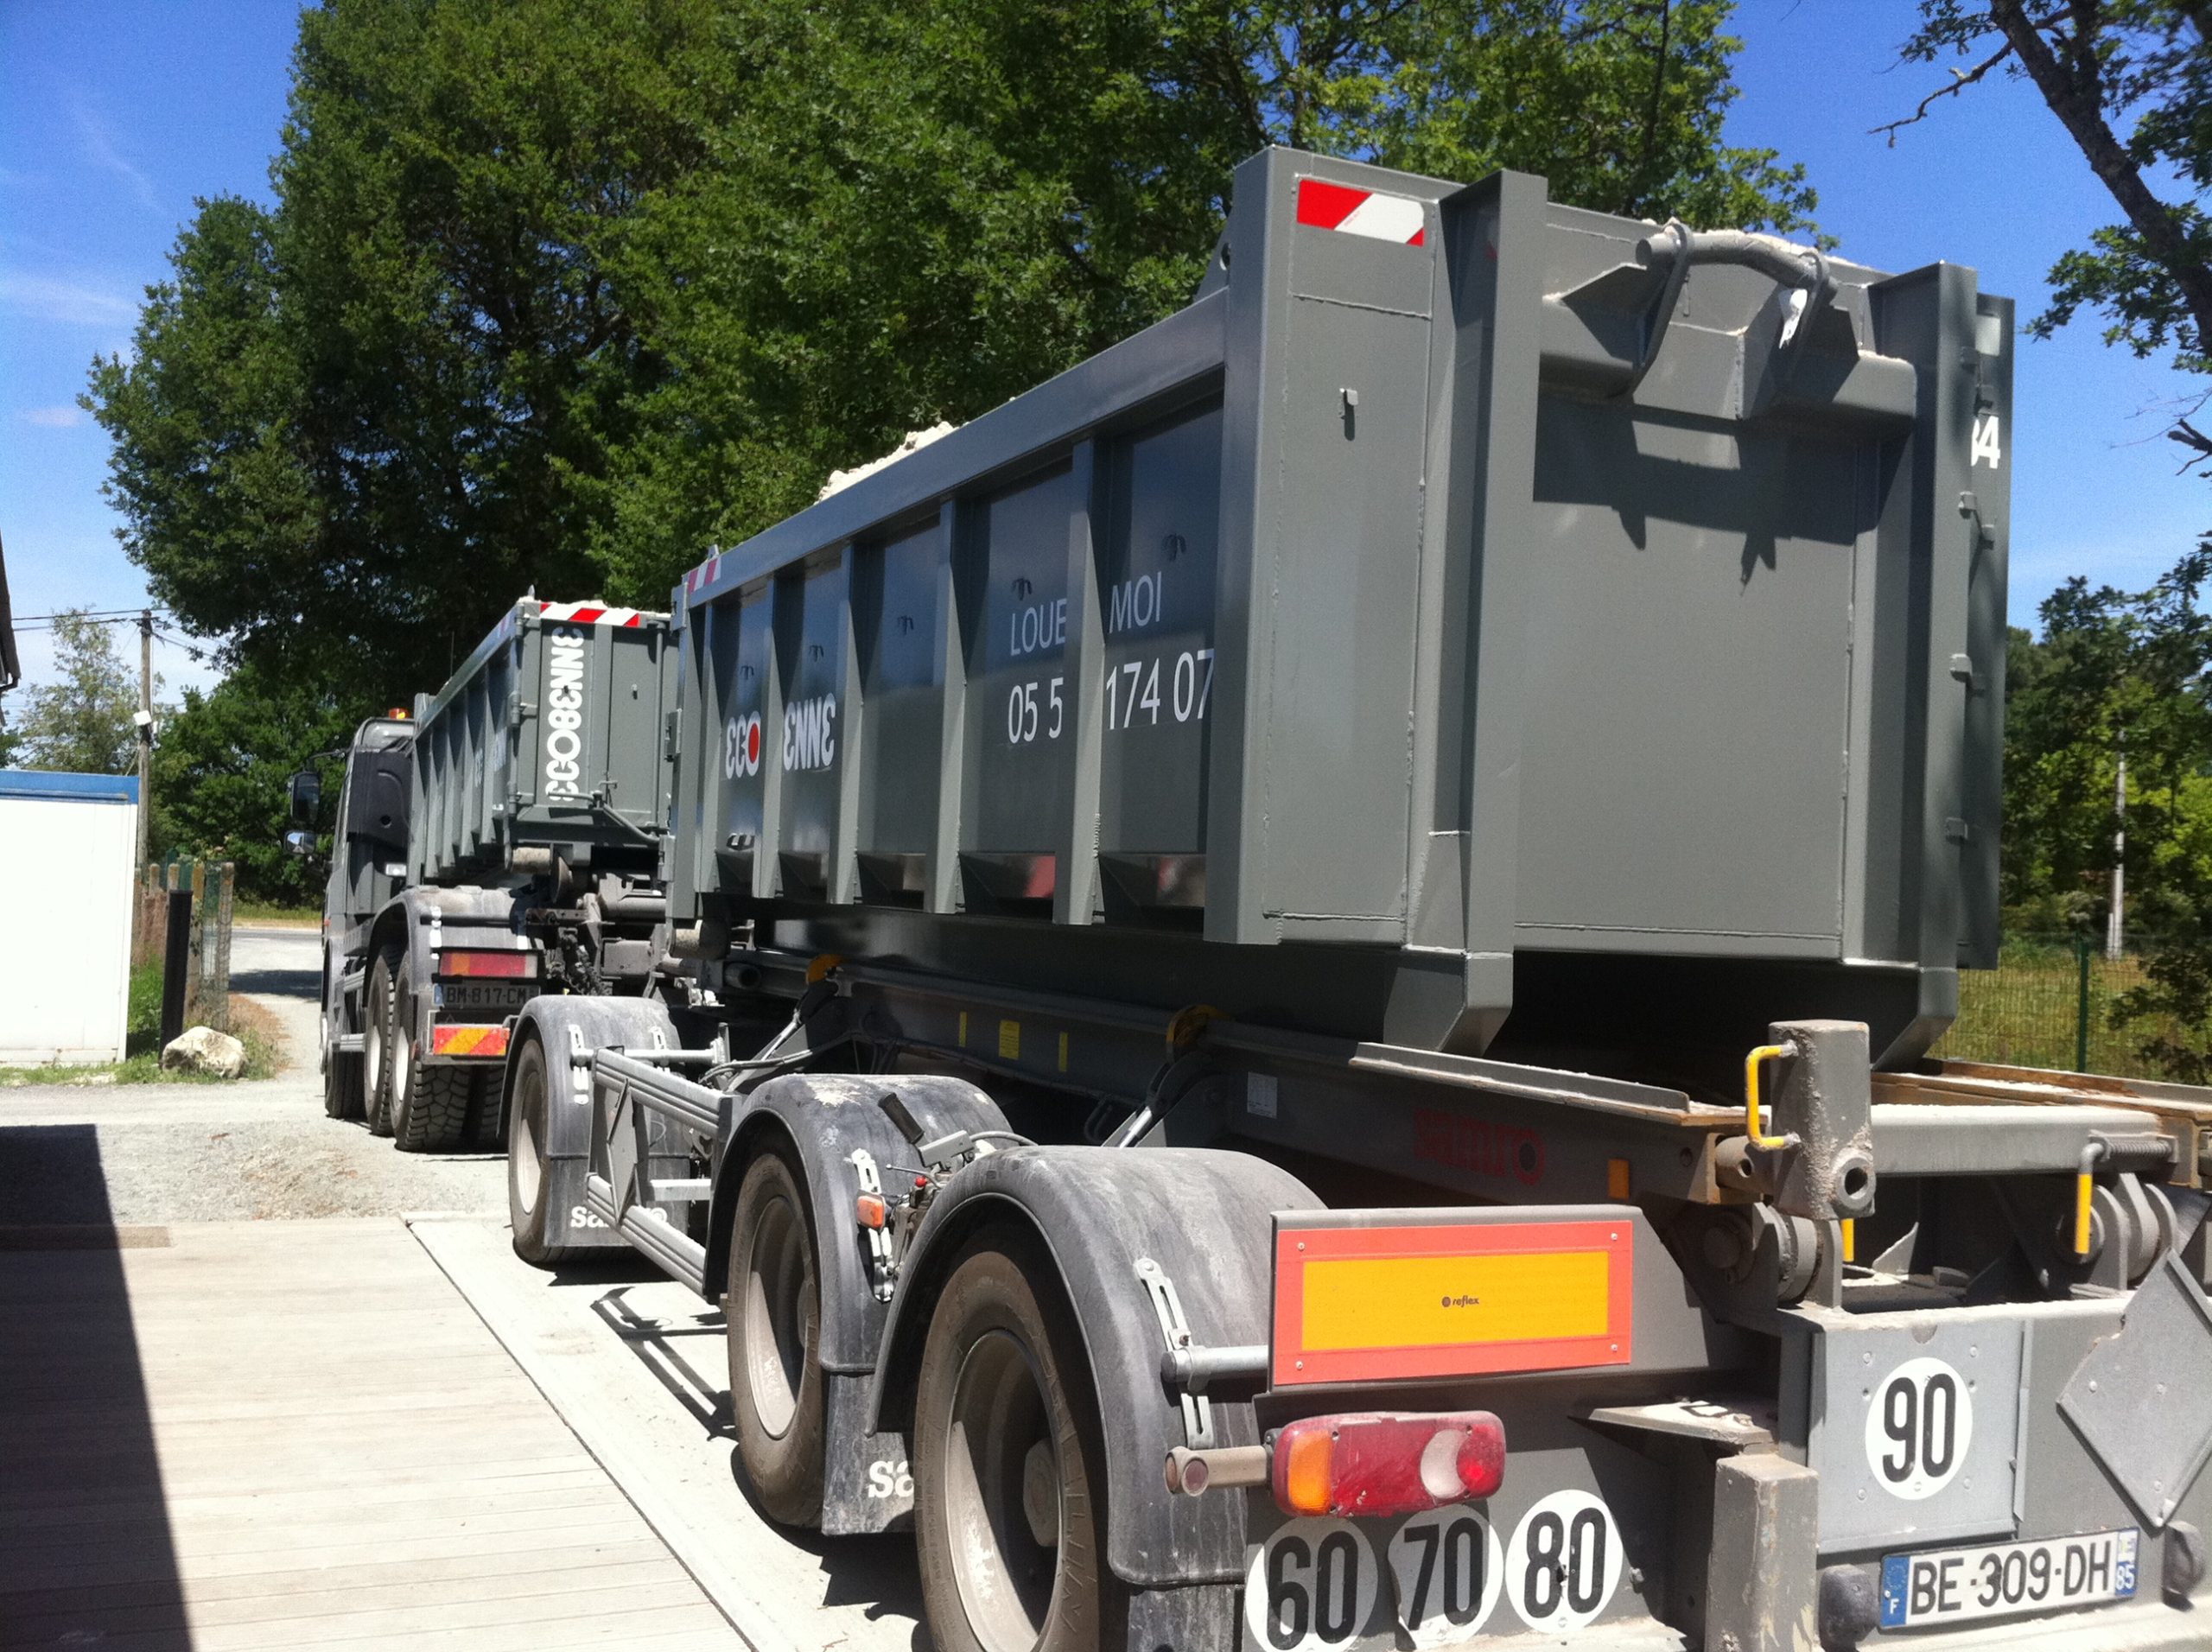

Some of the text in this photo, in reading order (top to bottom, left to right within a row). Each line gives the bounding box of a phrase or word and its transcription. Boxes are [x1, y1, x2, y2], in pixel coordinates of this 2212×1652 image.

[1109, 570, 1161, 633] MOI
[545, 626, 585, 802] ECOBENNE
[1008, 682, 1038, 744] 05
[1106, 658, 1160, 730] 174
[1173, 648, 1215, 723] 07
[1452, 1295, 1479, 1308] reflex
[1883, 1373, 1956, 1483] 90
[1265, 1529, 1358, 1651] 60
[1402, 1515, 1484, 1632] 70
[1525, 1508, 1606, 1619] 80
[1890, 1598, 1899, 1614] F
[1910, 1540, 2111, 1616] BE-309-DH
[2116, 1564, 2135, 1590] 85
